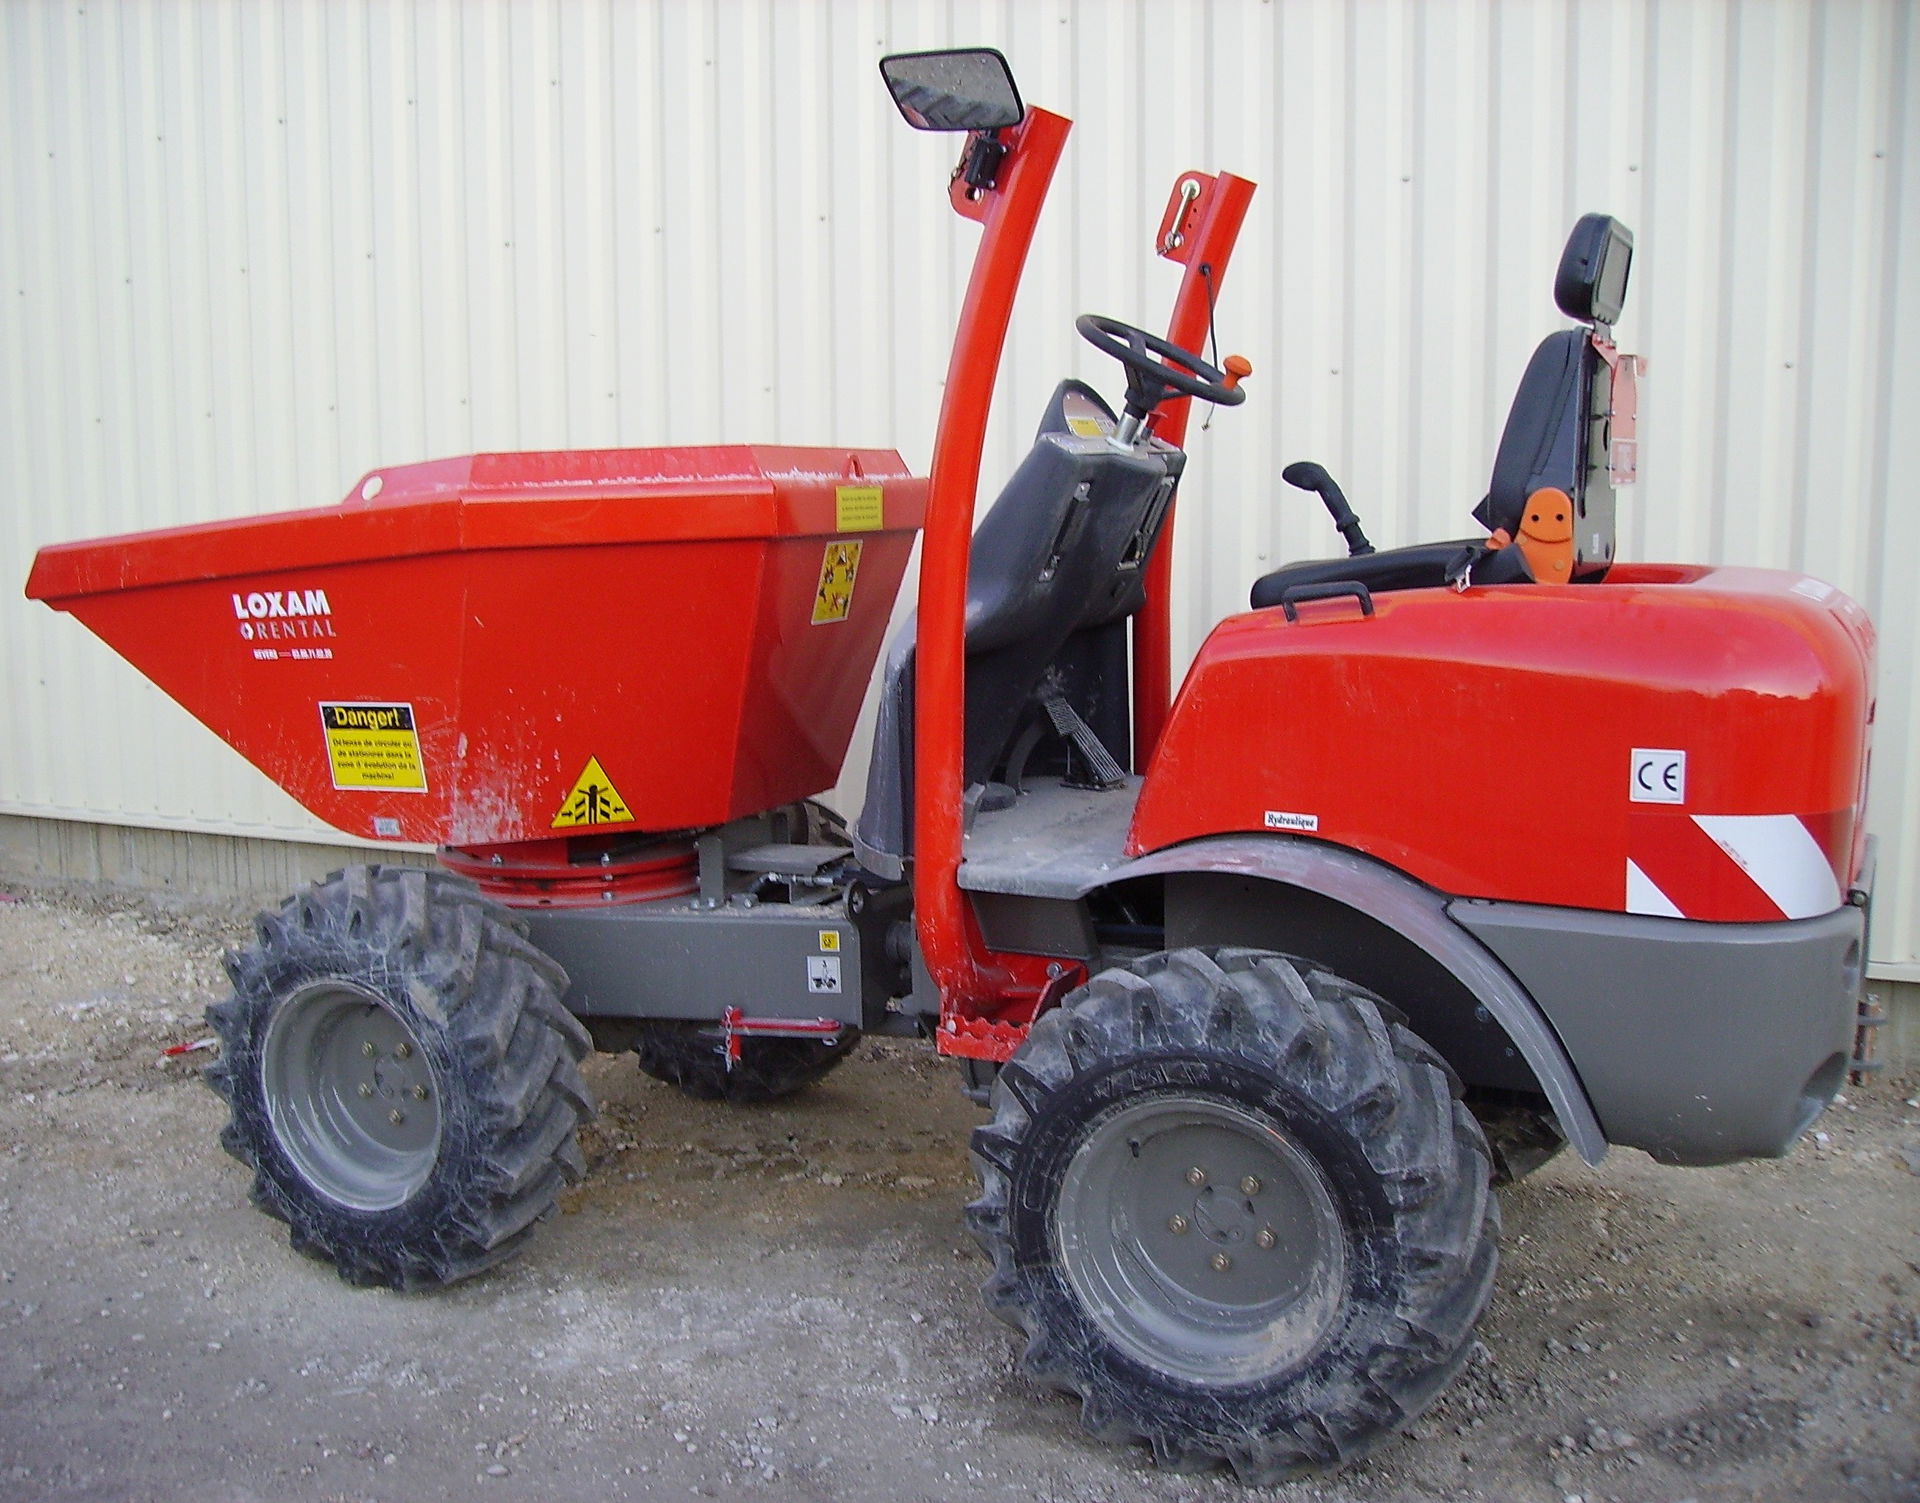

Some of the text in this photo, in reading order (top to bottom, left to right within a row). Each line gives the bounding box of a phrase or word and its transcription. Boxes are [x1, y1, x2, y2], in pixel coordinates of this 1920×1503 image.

[232, 589, 332, 619] LOXAM
[256, 619, 337, 640] RENTAL
[334, 707, 400, 731] Danger!
[363, 739, 372, 747] de
[385, 751, 403, 759] dans
[404, 751, 412, 759] la
[398, 762, 408, 770] de
[1638, 761, 1678, 792] CE
[1268, 812, 1315, 829] Hydraulique
